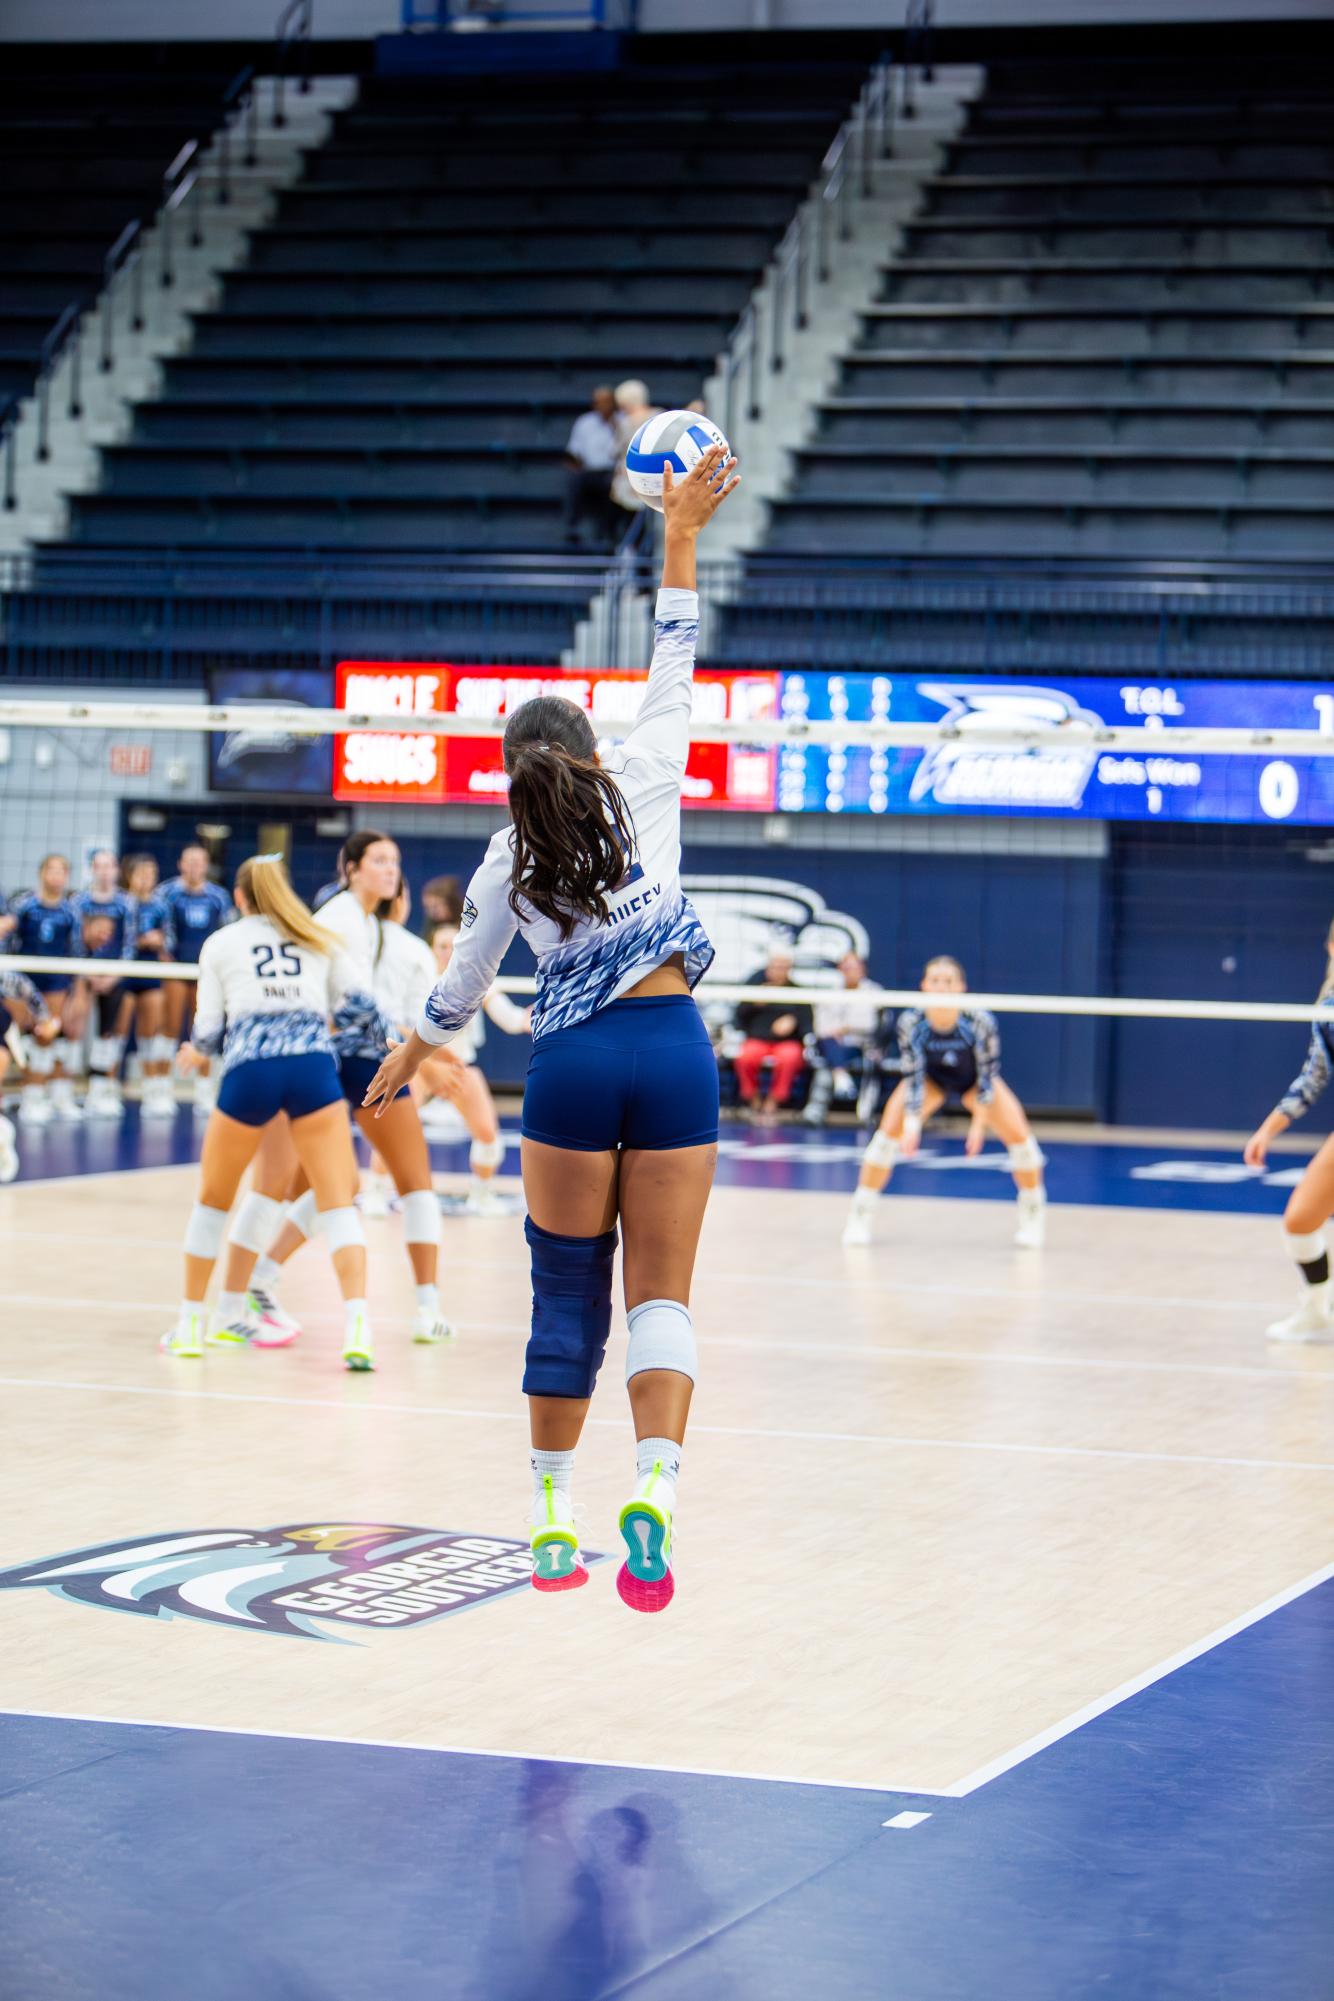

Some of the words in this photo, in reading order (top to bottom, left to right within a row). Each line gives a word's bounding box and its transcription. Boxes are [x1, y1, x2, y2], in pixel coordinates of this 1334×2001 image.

[1259, 760, 1299, 819] 0
[252, 941, 302, 977] 25
[271, 1538, 522, 1611] GEORGIA
[335, 1547, 534, 1623] SOUTHER
